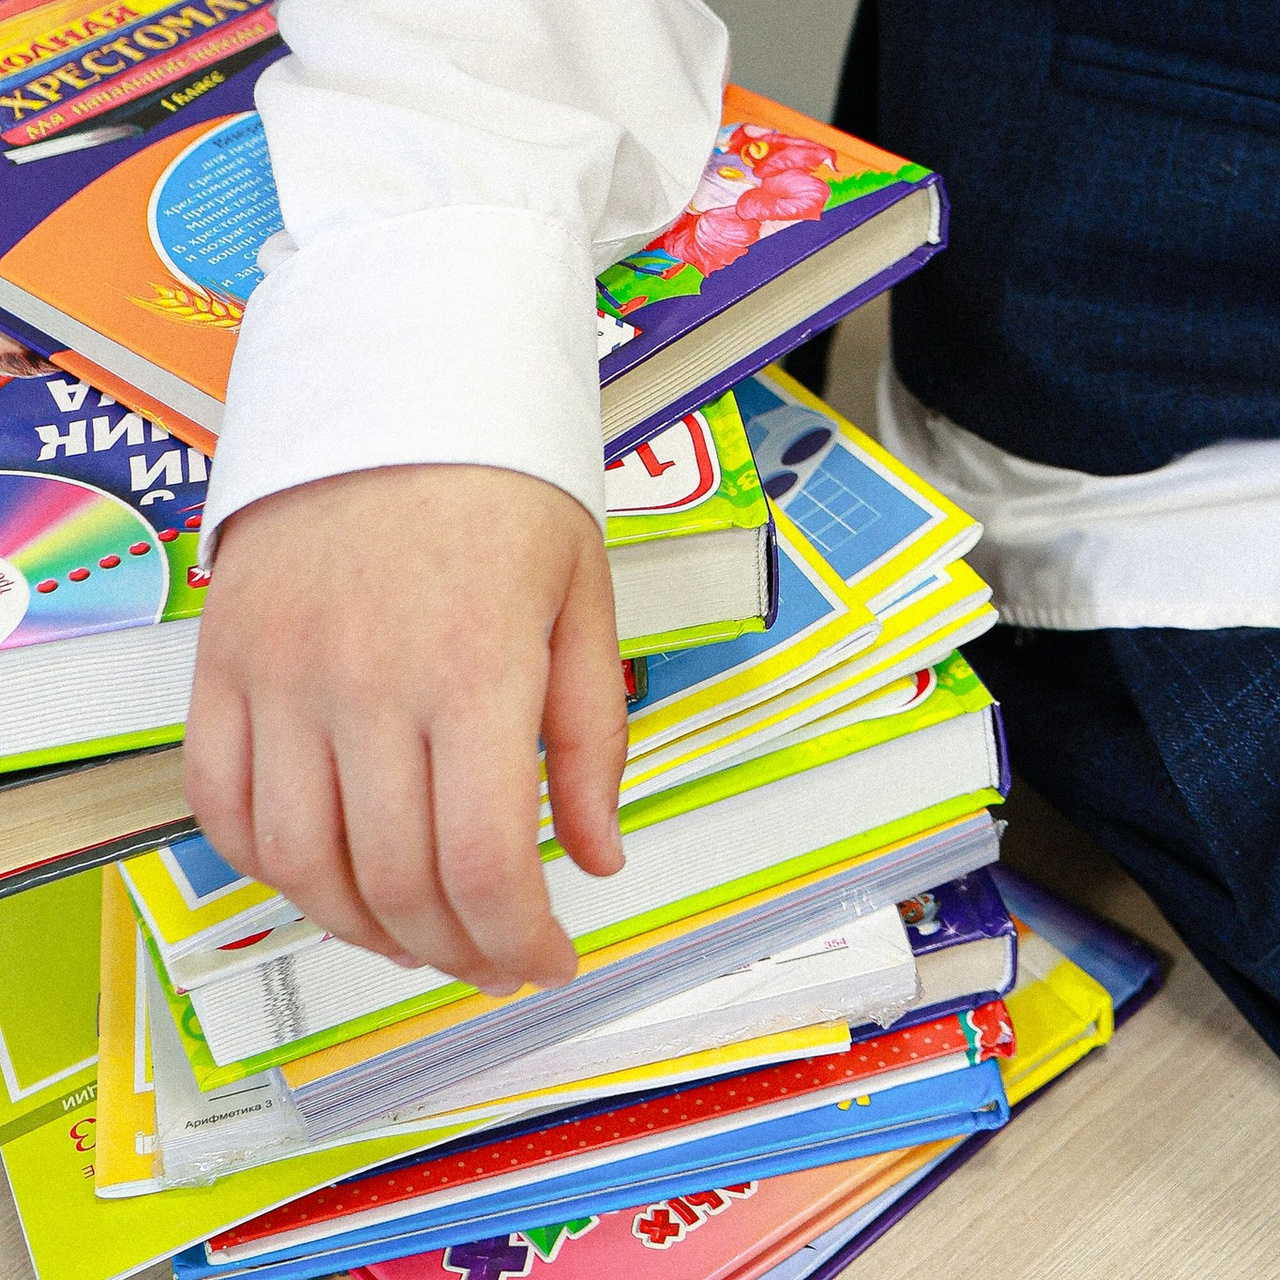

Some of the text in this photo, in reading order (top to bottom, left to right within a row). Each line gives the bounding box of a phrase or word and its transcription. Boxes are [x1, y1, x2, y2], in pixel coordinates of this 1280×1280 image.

[0, 6, 139, 74] ОЛНАЯ
[184, 1099, 273, 1130] Арифметика 3
